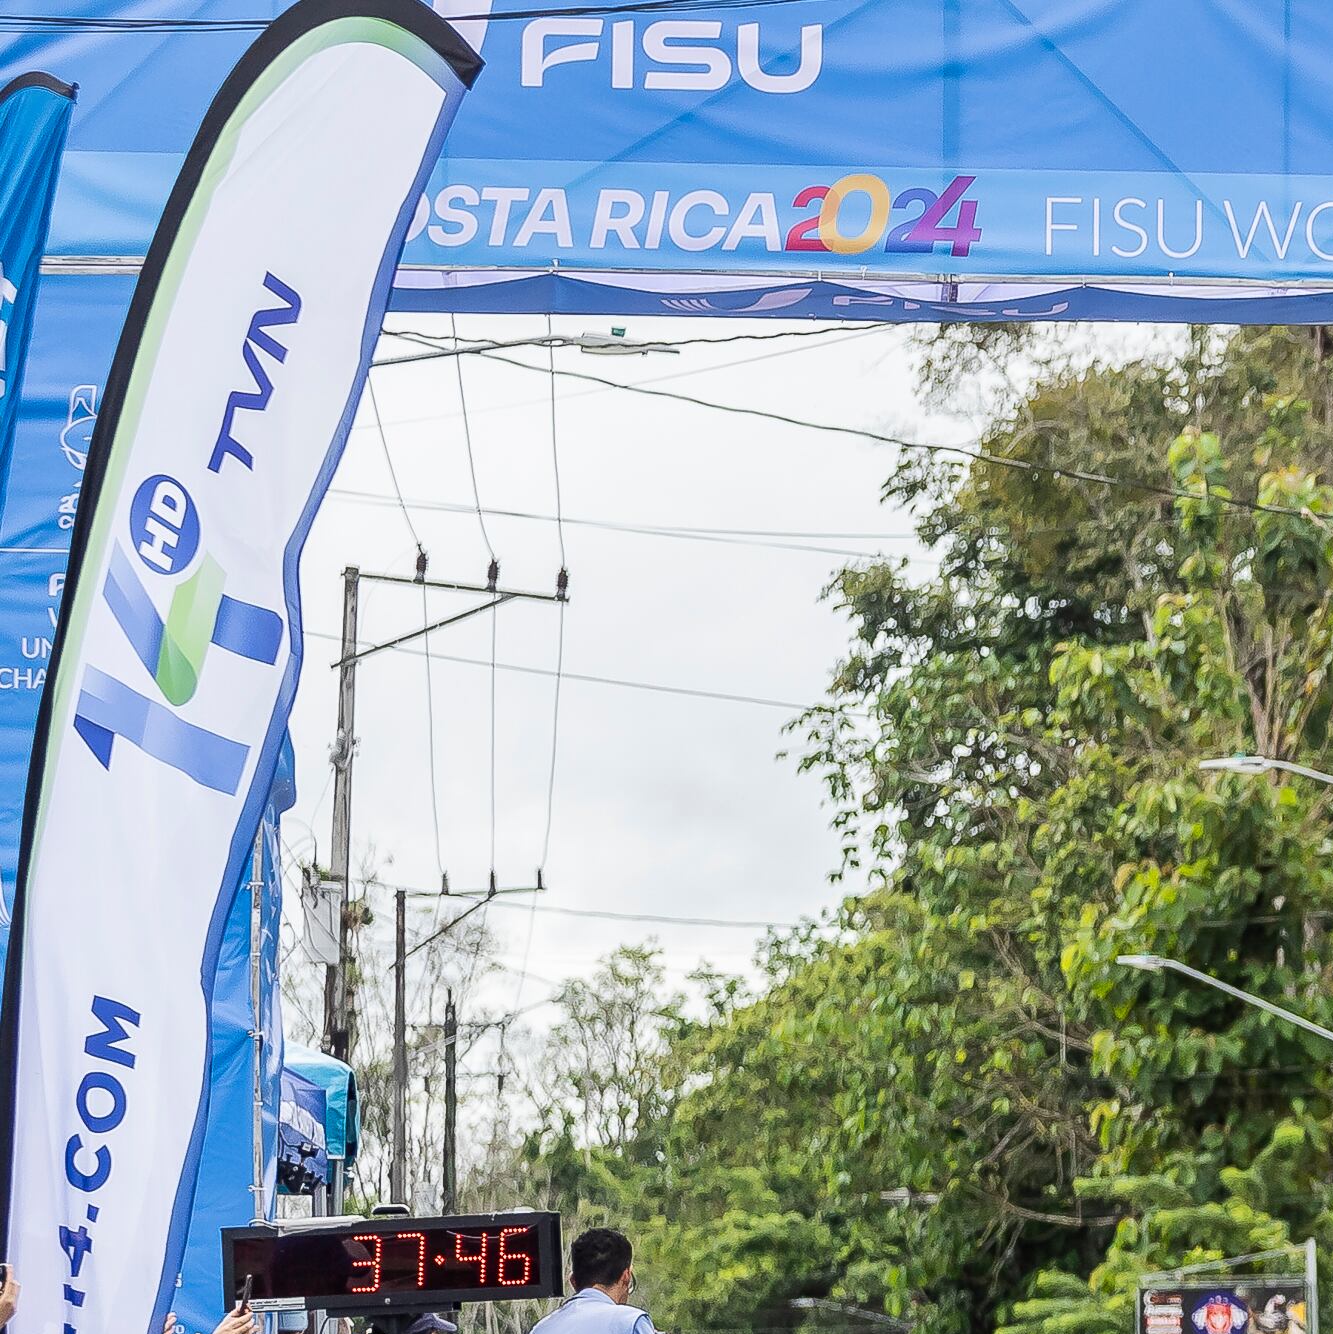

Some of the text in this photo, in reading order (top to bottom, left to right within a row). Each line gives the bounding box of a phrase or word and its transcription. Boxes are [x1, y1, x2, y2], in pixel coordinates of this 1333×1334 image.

[521, 18, 823, 94] FISU
[1045, 197, 1203, 257] FISU
[207, 271, 302, 473] TVN
[138, 480, 188, 572] HD
